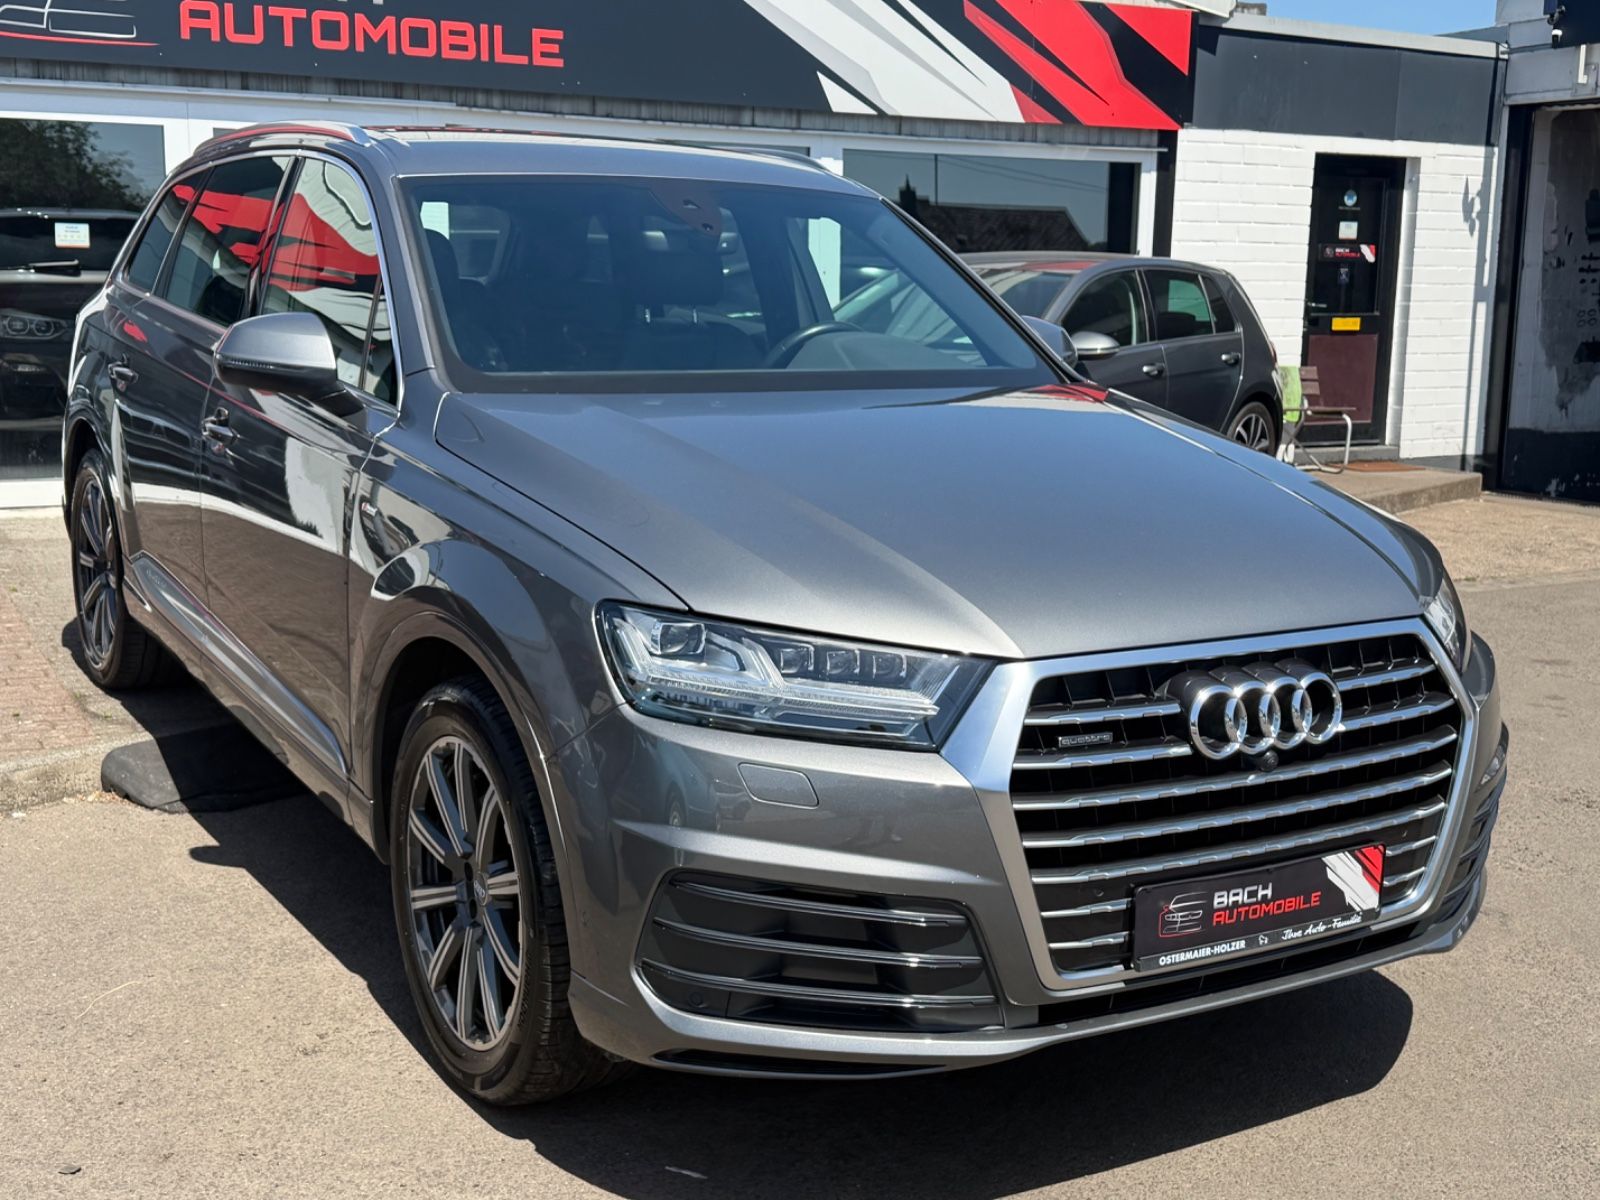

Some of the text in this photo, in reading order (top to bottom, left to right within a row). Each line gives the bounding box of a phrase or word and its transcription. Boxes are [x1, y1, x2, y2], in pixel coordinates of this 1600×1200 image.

[179, 0, 564, 68] AUTOMOBILE
[1212, 891, 1322, 926] AUTOMOBILE
[1213, 882, 1273, 909] BACH
[1158, 939, 1246, 966] OSTERMAIER-HOLZER
